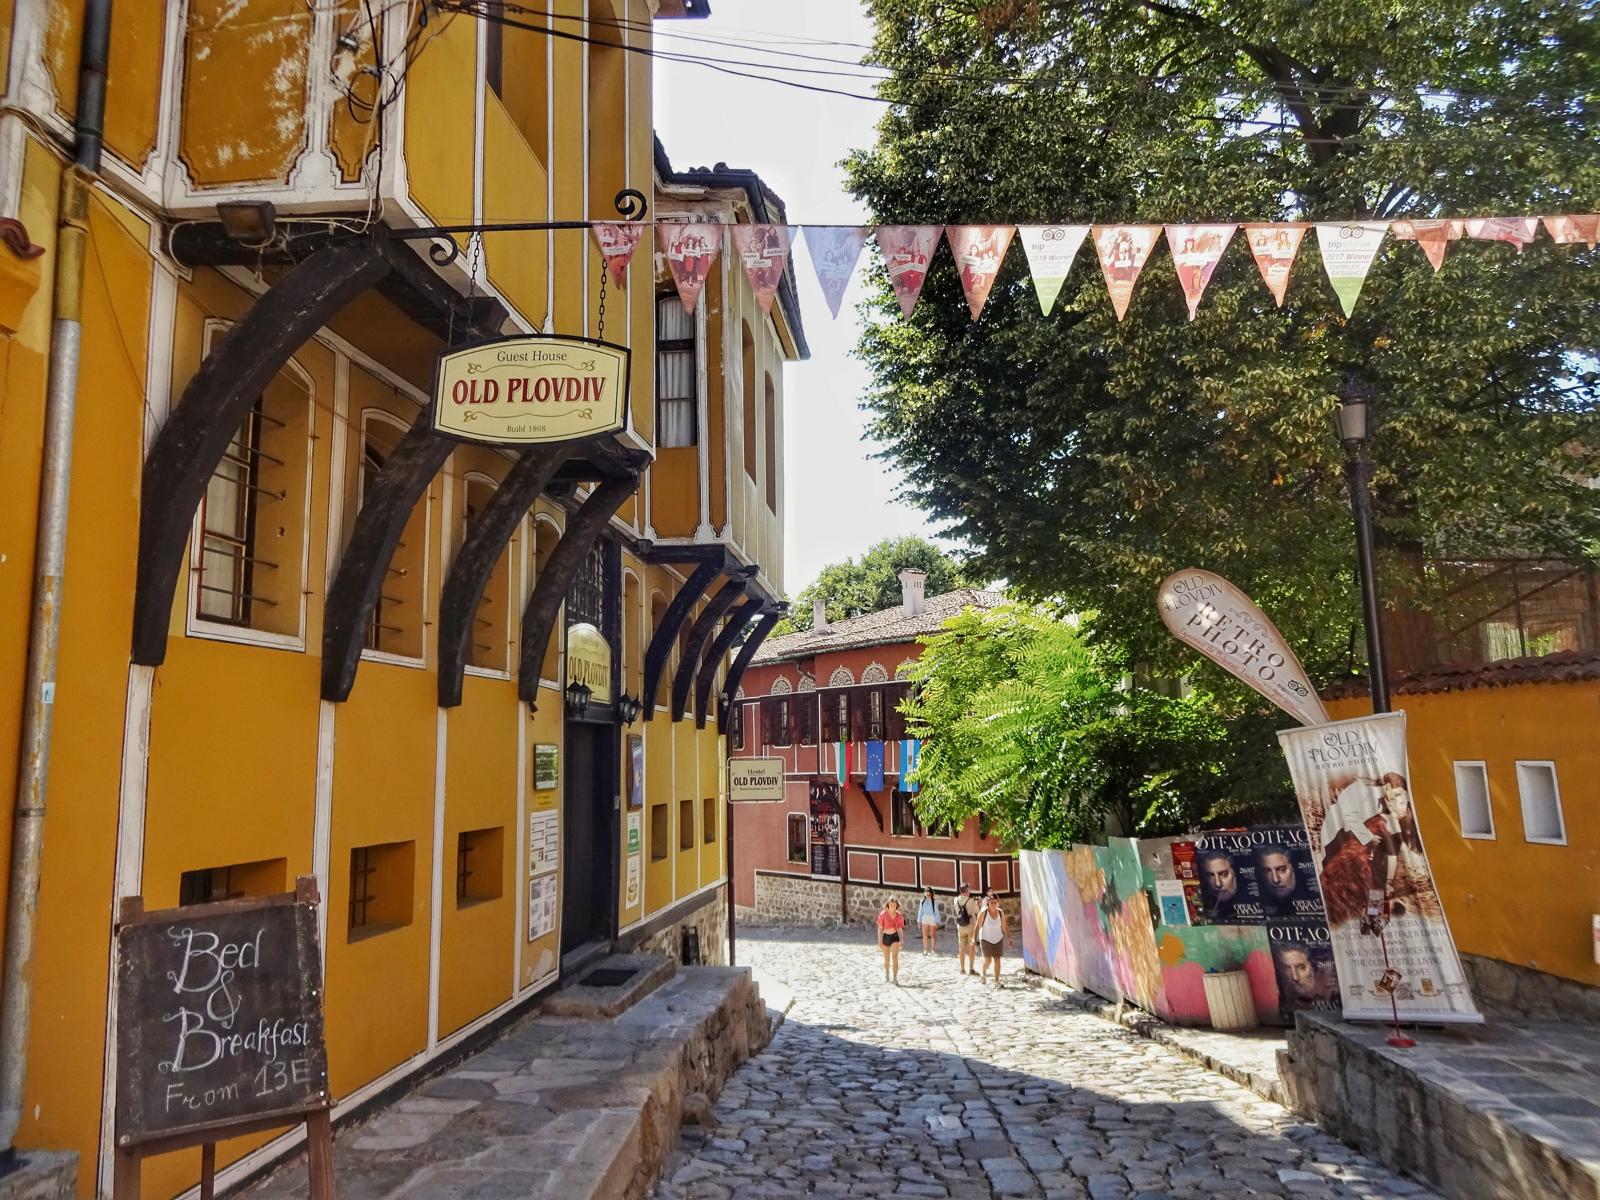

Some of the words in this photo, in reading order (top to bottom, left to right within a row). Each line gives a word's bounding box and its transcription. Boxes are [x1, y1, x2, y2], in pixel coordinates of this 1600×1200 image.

[1346, 253, 1372, 261] Winner
[497, 351, 528, 362] Guest
[533, 350, 567, 361] House
[452, 379, 499, 405] OLD
[506, 377, 606, 403] PLOVDIV
[1173, 575, 1204, 593] OLD
[1187, 614, 1275, 681] PHOTO
[1200, 602, 1285, 668] RETRO
[1308, 742, 1377, 762] PLOVDIV
[1324, 731, 1360, 746] OLD
[734, 777, 748, 786] OLD
[750, 776, 779, 786] PLOVDIV
[168, 926, 267, 994] Bed
[206, 970, 242, 1029] &
[158, 1006, 311, 1073] Breakfast
[165, 1082, 239, 1113] From
